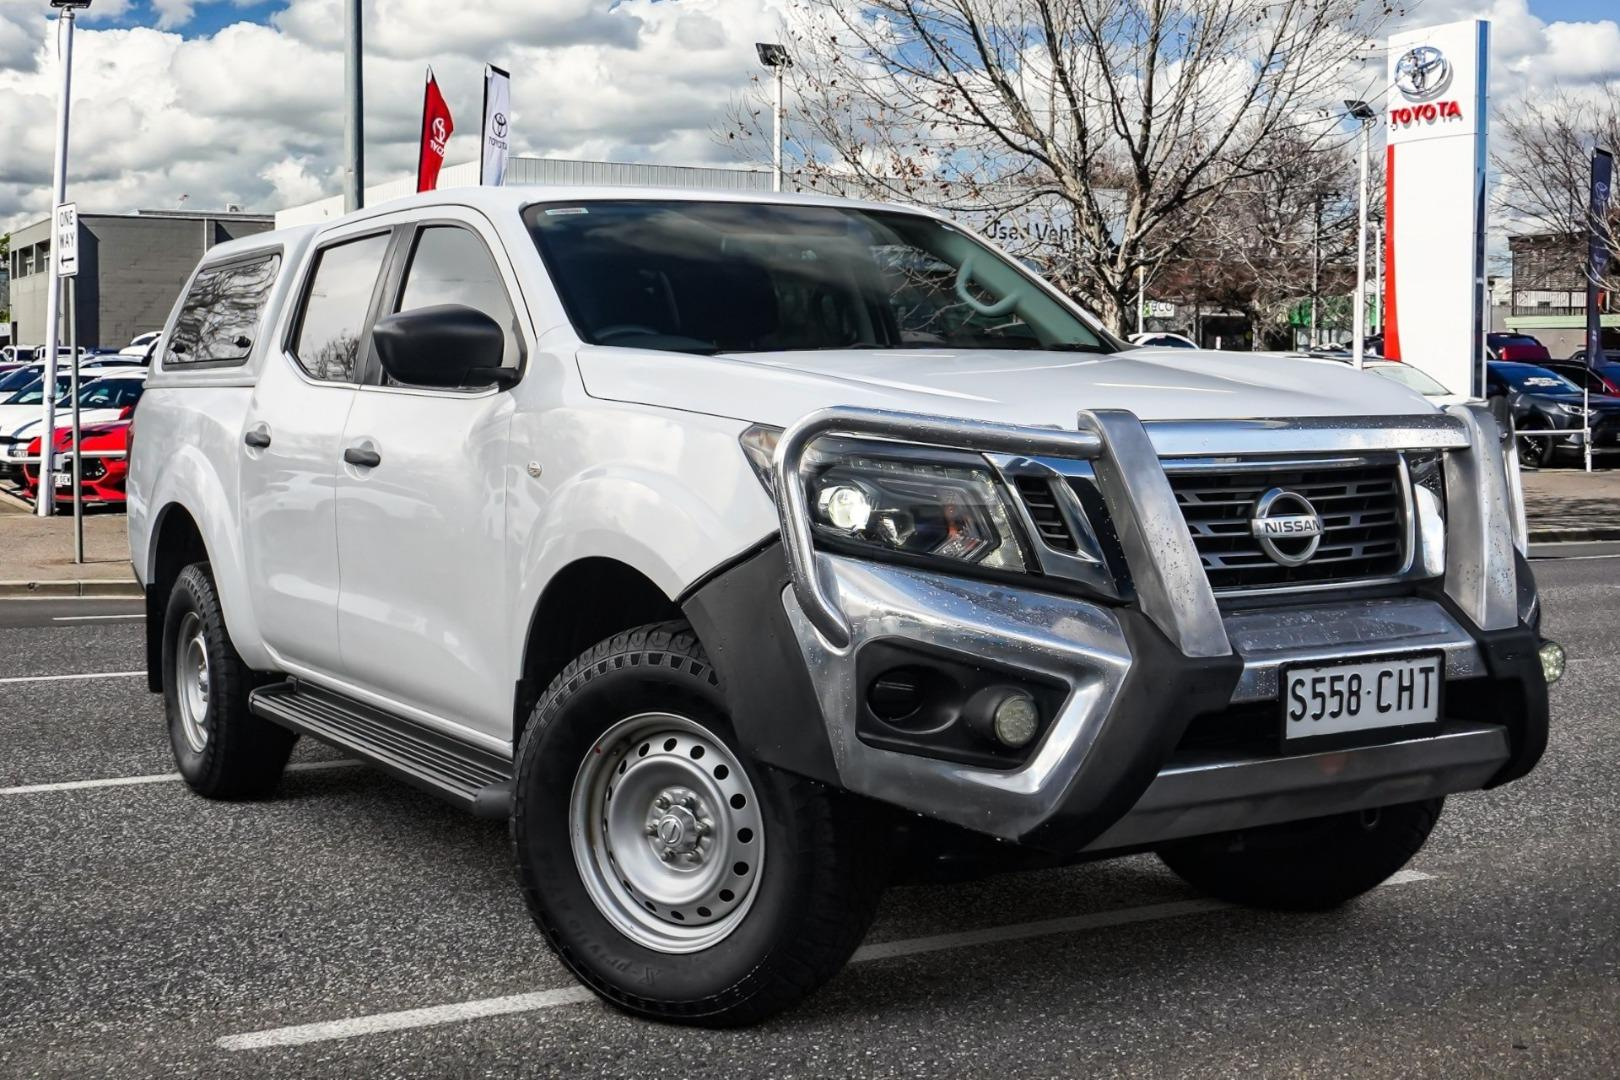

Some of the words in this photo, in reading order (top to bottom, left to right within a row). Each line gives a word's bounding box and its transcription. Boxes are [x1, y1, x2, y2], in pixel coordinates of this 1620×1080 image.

[1390, 100, 1462, 124] TOYOTA
[488, 136, 508, 150] TOYOTA
[60, 210, 74, 228] ONE
[984, 220, 1030, 240] Used
[60, 232, 75, 249] WAY
[1264, 519, 1321, 533] NISSAN
